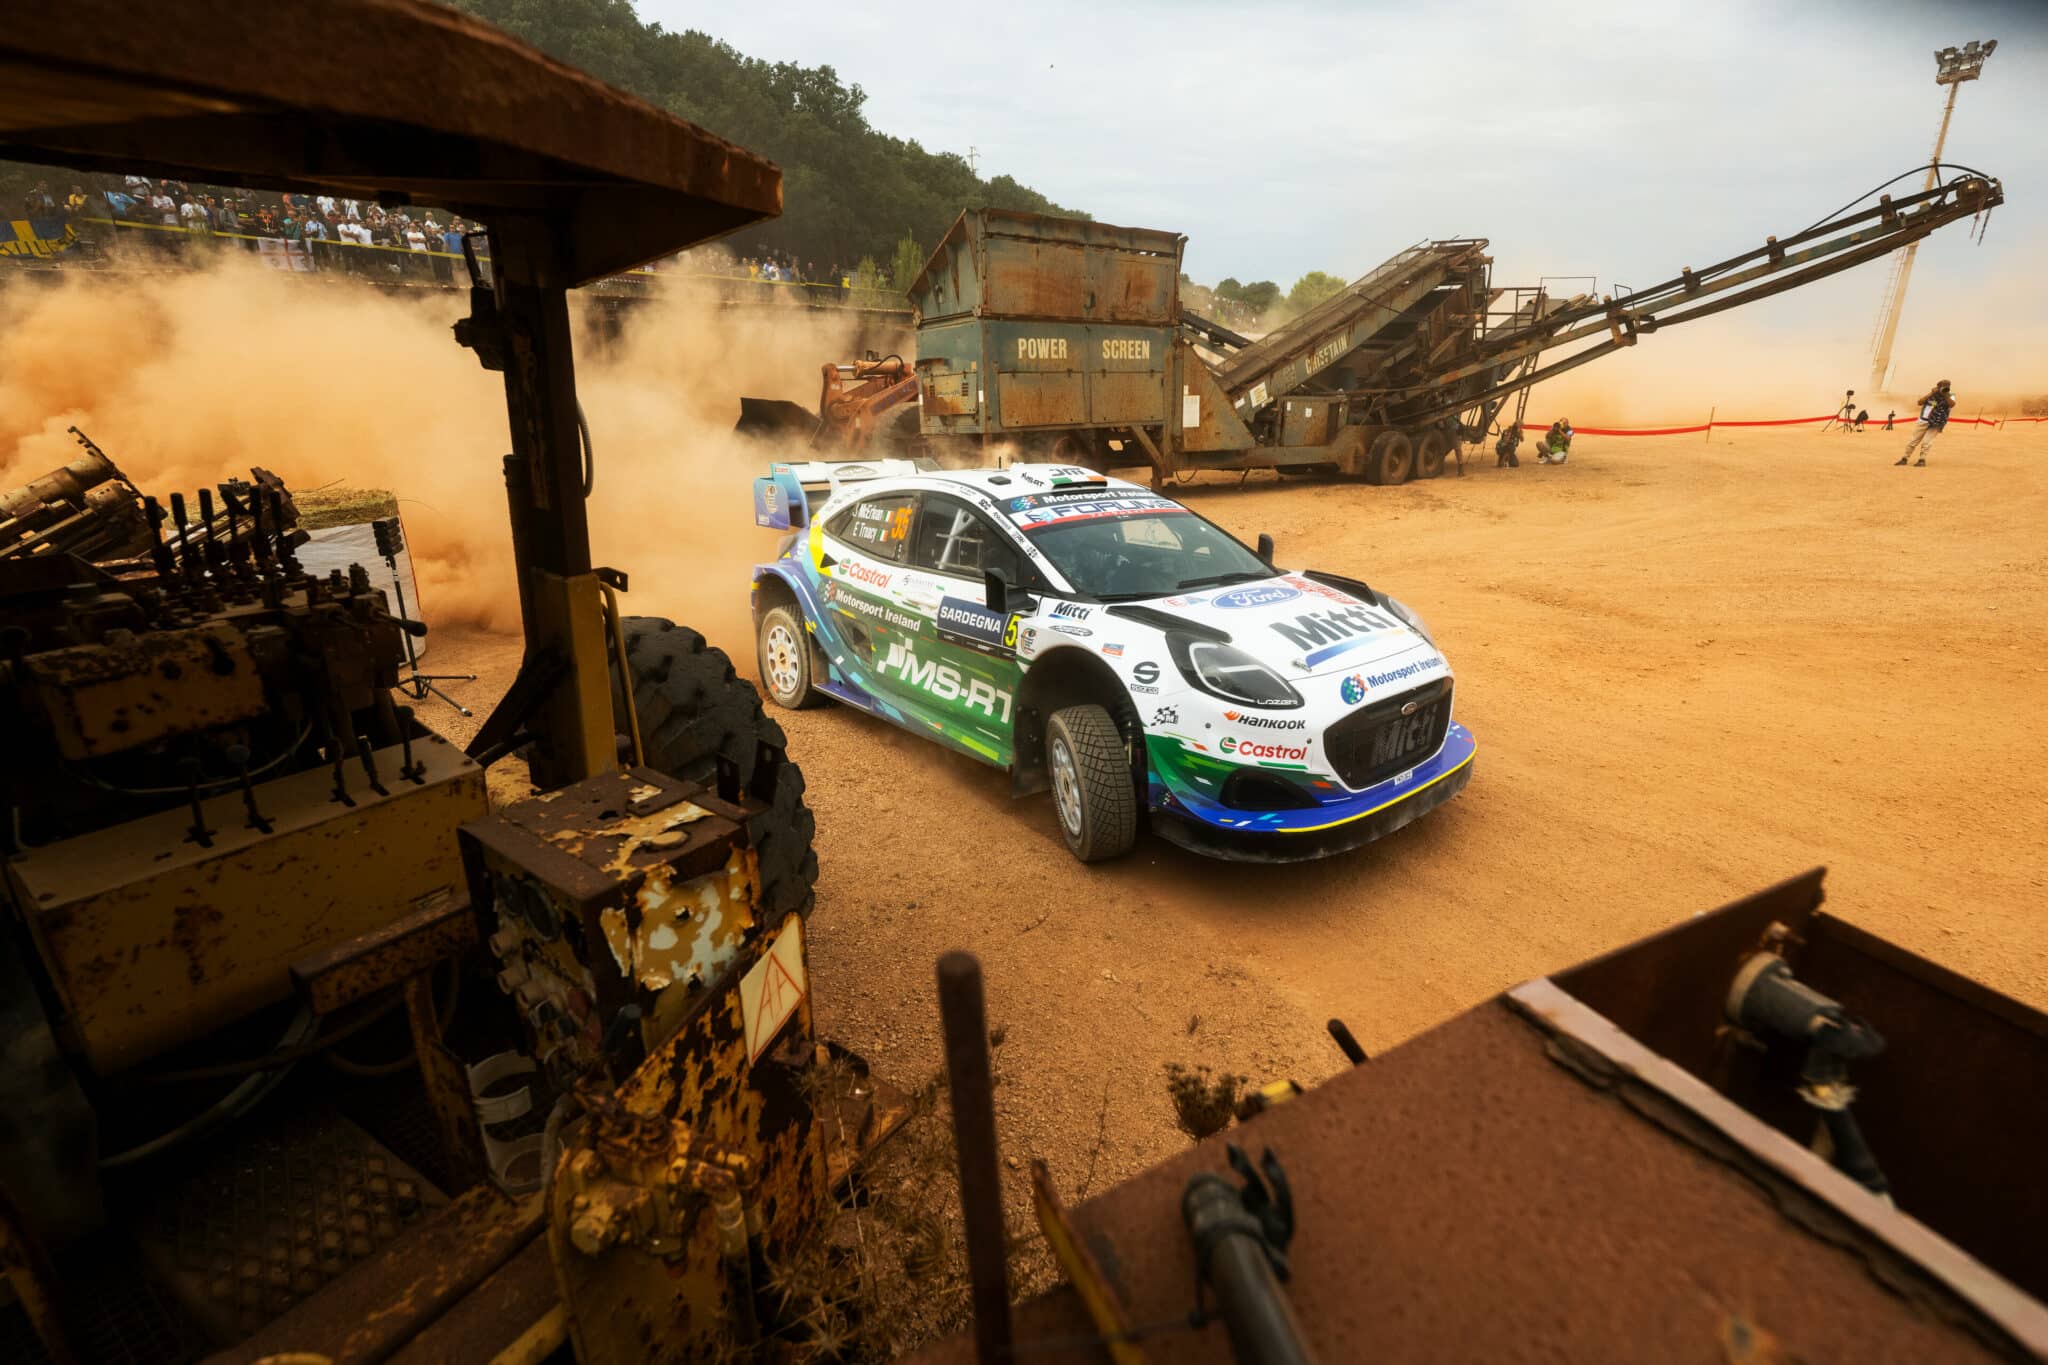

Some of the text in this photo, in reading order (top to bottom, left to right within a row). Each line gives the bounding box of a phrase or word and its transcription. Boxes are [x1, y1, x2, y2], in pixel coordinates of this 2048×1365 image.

[1018, 338, 1150, 360] POWER SCREEN
[1042, 490, 1116, 505] Motorsport
[849, 563, 892, 589] Castrol
[836, 590, 920, 632] Motorsport Ireland
[940, 606, 1001, 634] SARDEGNA
[1053, 601, 1093, 620] Mitti
[1269, 606, 1397, 651] Mitti
[1366, 663, 1420, 688] Motorsport
[1238, 740, 1307, 760] Castrol
